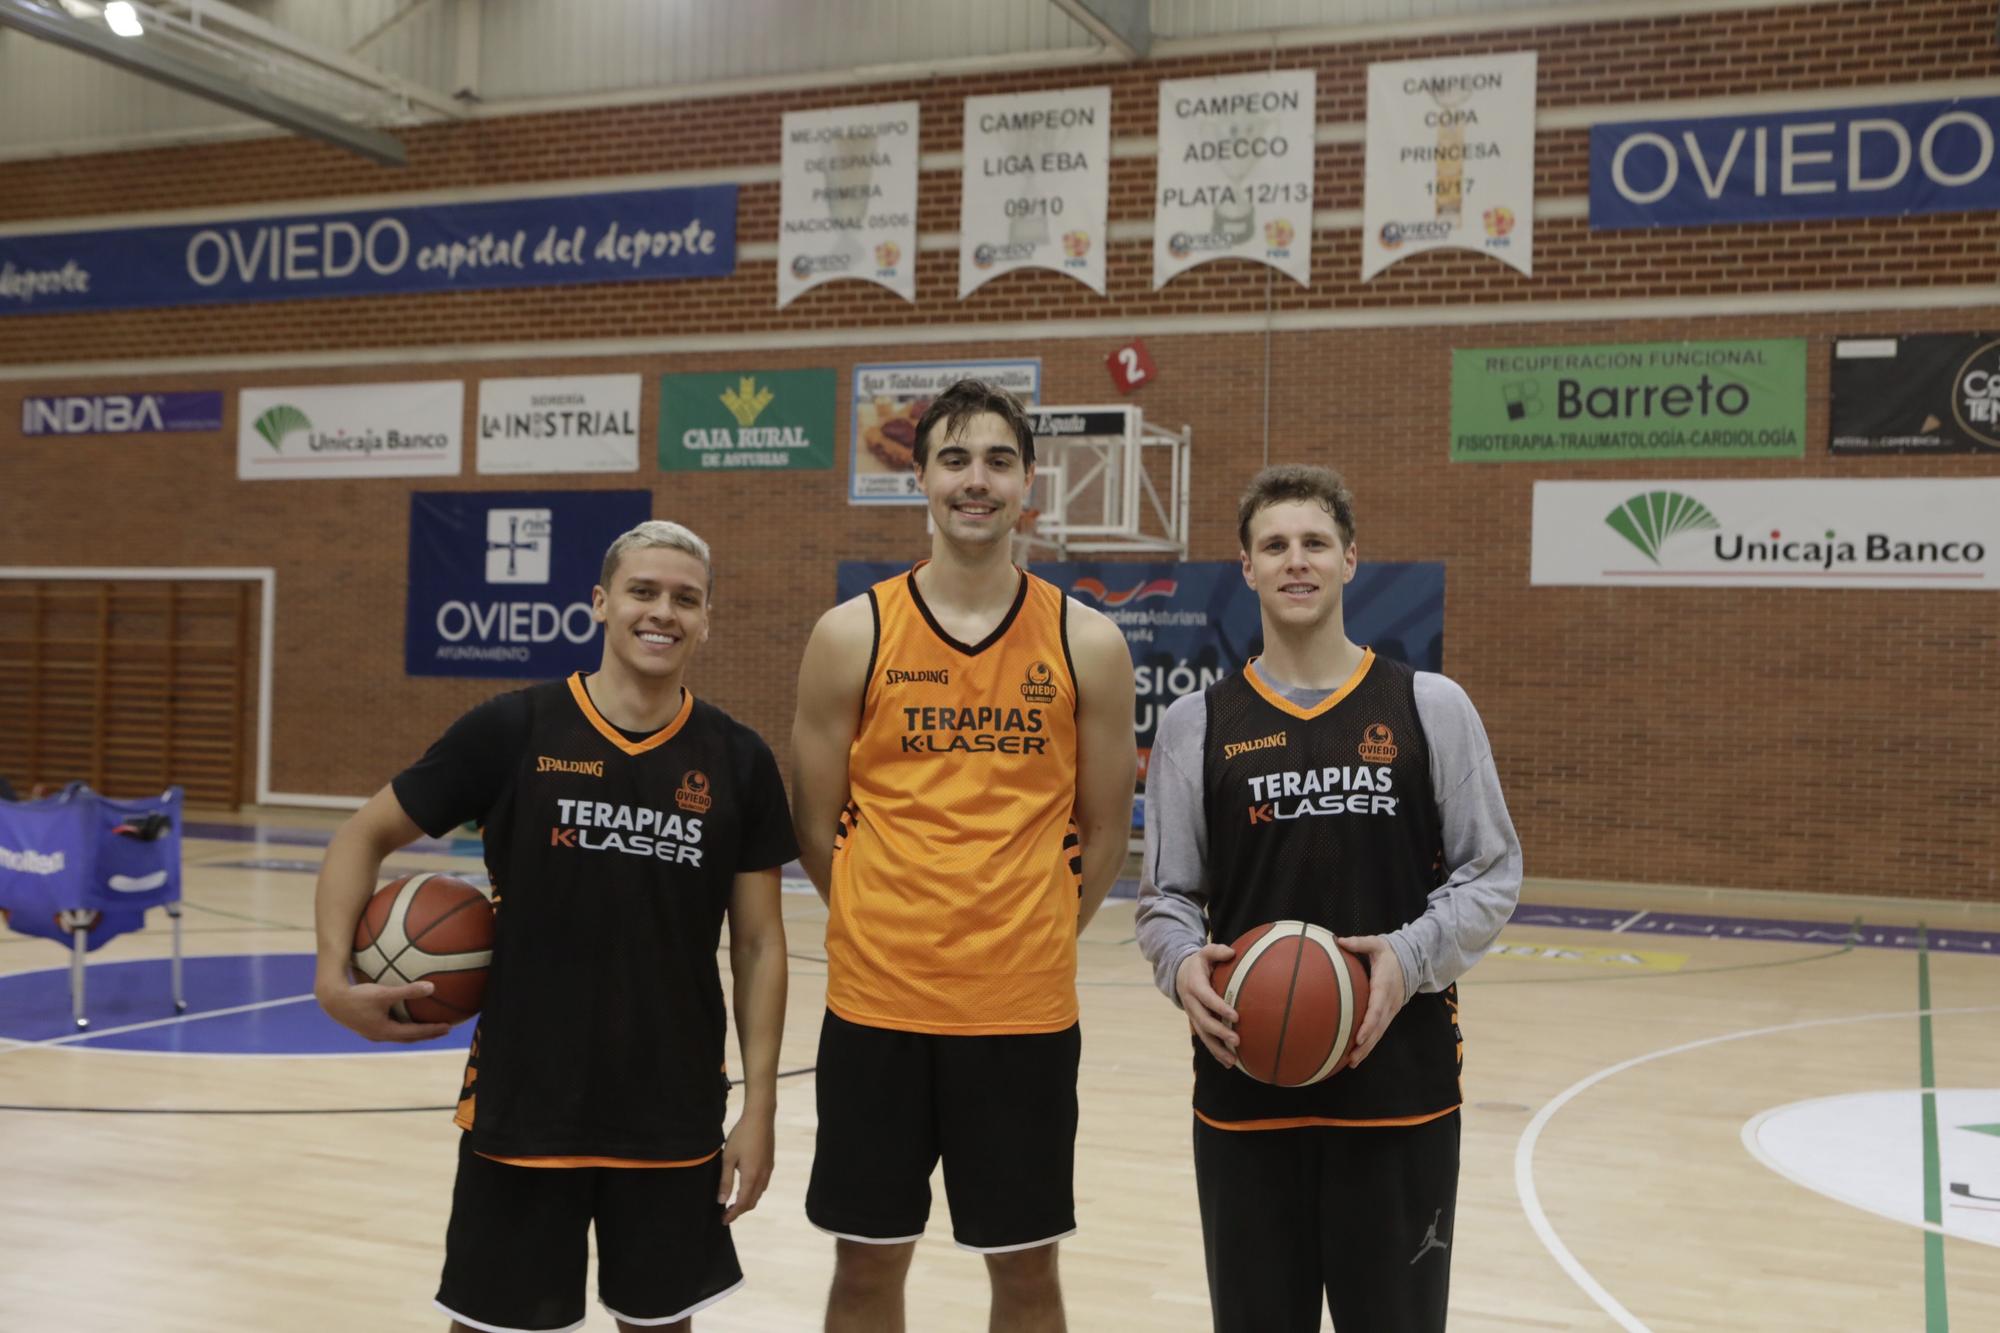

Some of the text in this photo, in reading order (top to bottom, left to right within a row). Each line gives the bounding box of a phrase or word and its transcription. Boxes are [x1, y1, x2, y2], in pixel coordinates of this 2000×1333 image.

[1403, 73, 1502, 95] CAMPEON
[1175, 91, 1299, 118] CAMPEON
[980, 107, 1095, 134] CAMPEON
[1425, 109, 1478, 127] COPA
[790, 120, 908, 144] MEJOR EQUIPO
[1183, 137, 1288, 163] ADECCO
[1400, 143, 1500, 163] PRINCESA
[1611, 111, 1995, 205] OVIEDO
[804, 157, 827, 173] DE
[983, 152, 1088, 177] LIGA EBA
[812, 184, 883, 202] PRIMERA
[1162, 183, 1310, 208] PLATA 12/13
[1425, 178, 1475, 197] 16/17
[1004, 197, 1063, 218] 09/10
[784, 215, 863, 234] NACIONAL
[186, 218, 716, 286] OVIEDO capital del deporte
[1117, 347, 1146, 385] 2
[1650, 350, 1766, 368] FUNCIONAL
[1558, 374, 1750, 420] Barreto
[23, 395, 164, 433] INDIBA
[308, 428, 448, 455] Unicaja Banco
[682, 426, 809, 449] CAJA RURAL
[702, 451, 789, 467] DE ASTURIAS
[1714, 530, 1986, 569] Unicaja Banco
[436, 600, 598, 644] OVIEDO
[886, 669, 948, 685] SPALDING
[1135, 658, 1224, 696] SIÓN
[1021, 684, 1056, 697] OVIEDO
[903, 706, 1042, 733] TERAPIAS
[1224, 731, 1287, 760] SPALDING
[1359, 744, 1396, 757] OVIEDO
[536, 755, 604, 778] SPALDING
[1248, 765, 1393, 802] TERAPIAS
[676, 790, 711, 807] OVIEDO
[557, 798, 703, 844] TERAPIAS
